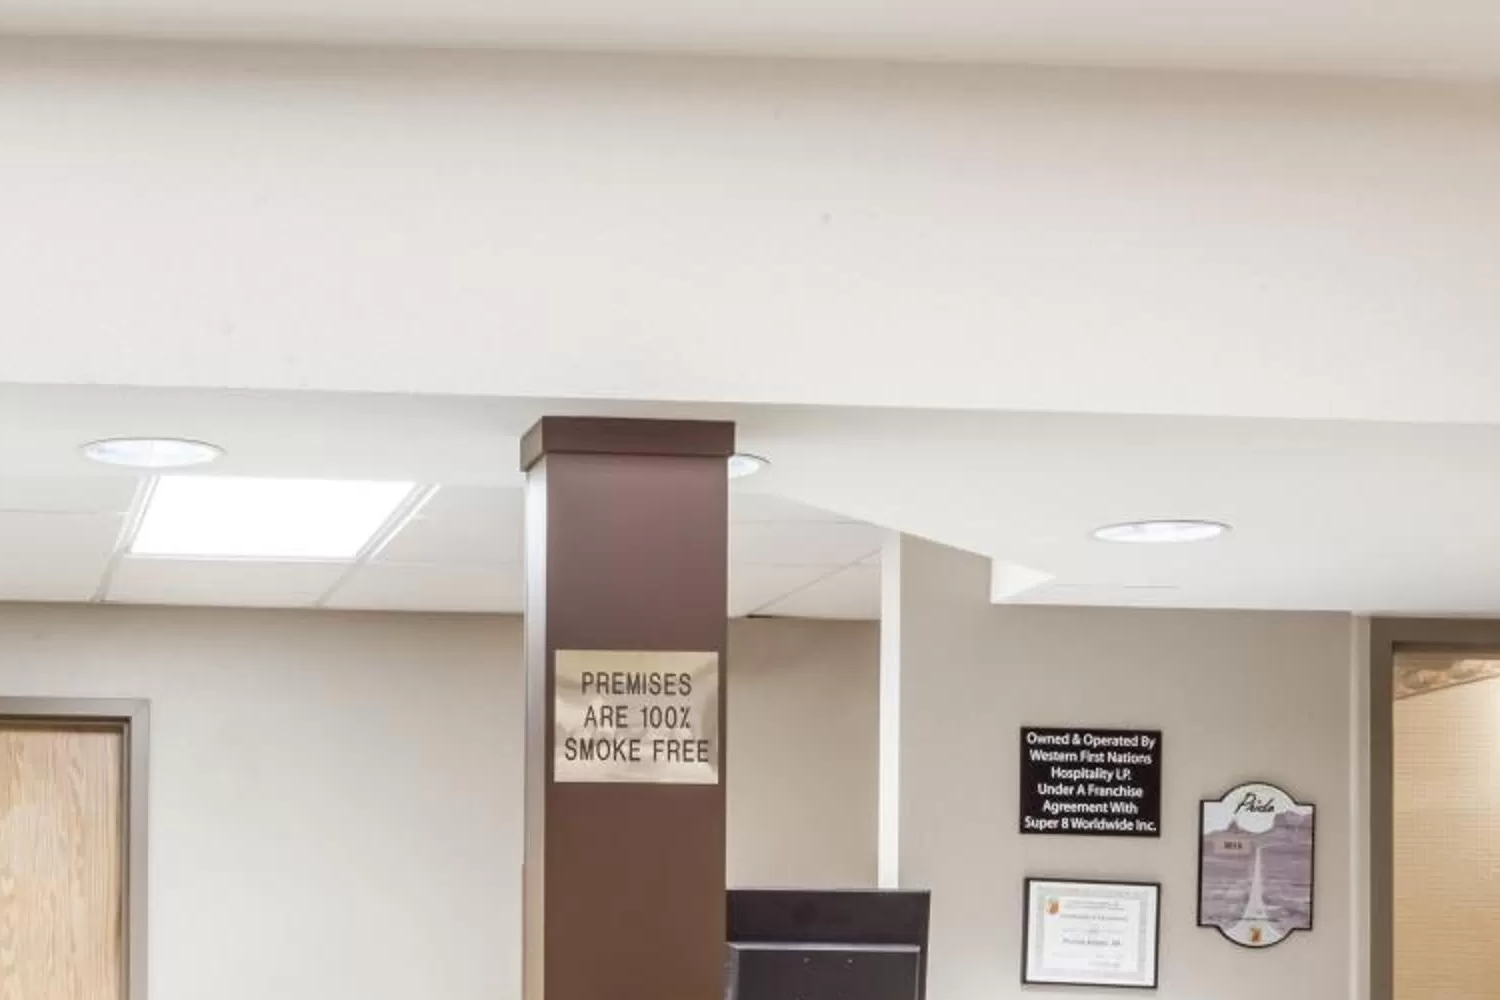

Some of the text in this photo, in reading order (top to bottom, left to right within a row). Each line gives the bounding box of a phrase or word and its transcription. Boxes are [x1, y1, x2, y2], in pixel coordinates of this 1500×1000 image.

[581, 671, 692, 695] PREMISES
[583, 705, 690, 728] ARE 100%
[1026, 731, 1156, 750] Owned & Operated By
[564, 738, 709, 762] SMOKE FREE
[1029, 749, 1152, 765] Western First Nations
[1051, 766, 1113, 783] Hospitality
[1037, 783, 1143, 798] Under A Franchise
[1043, 800, 1138, 815] Agreement With
[1024, 816, 1157, 831] Super 8 Worldwide Inc.
